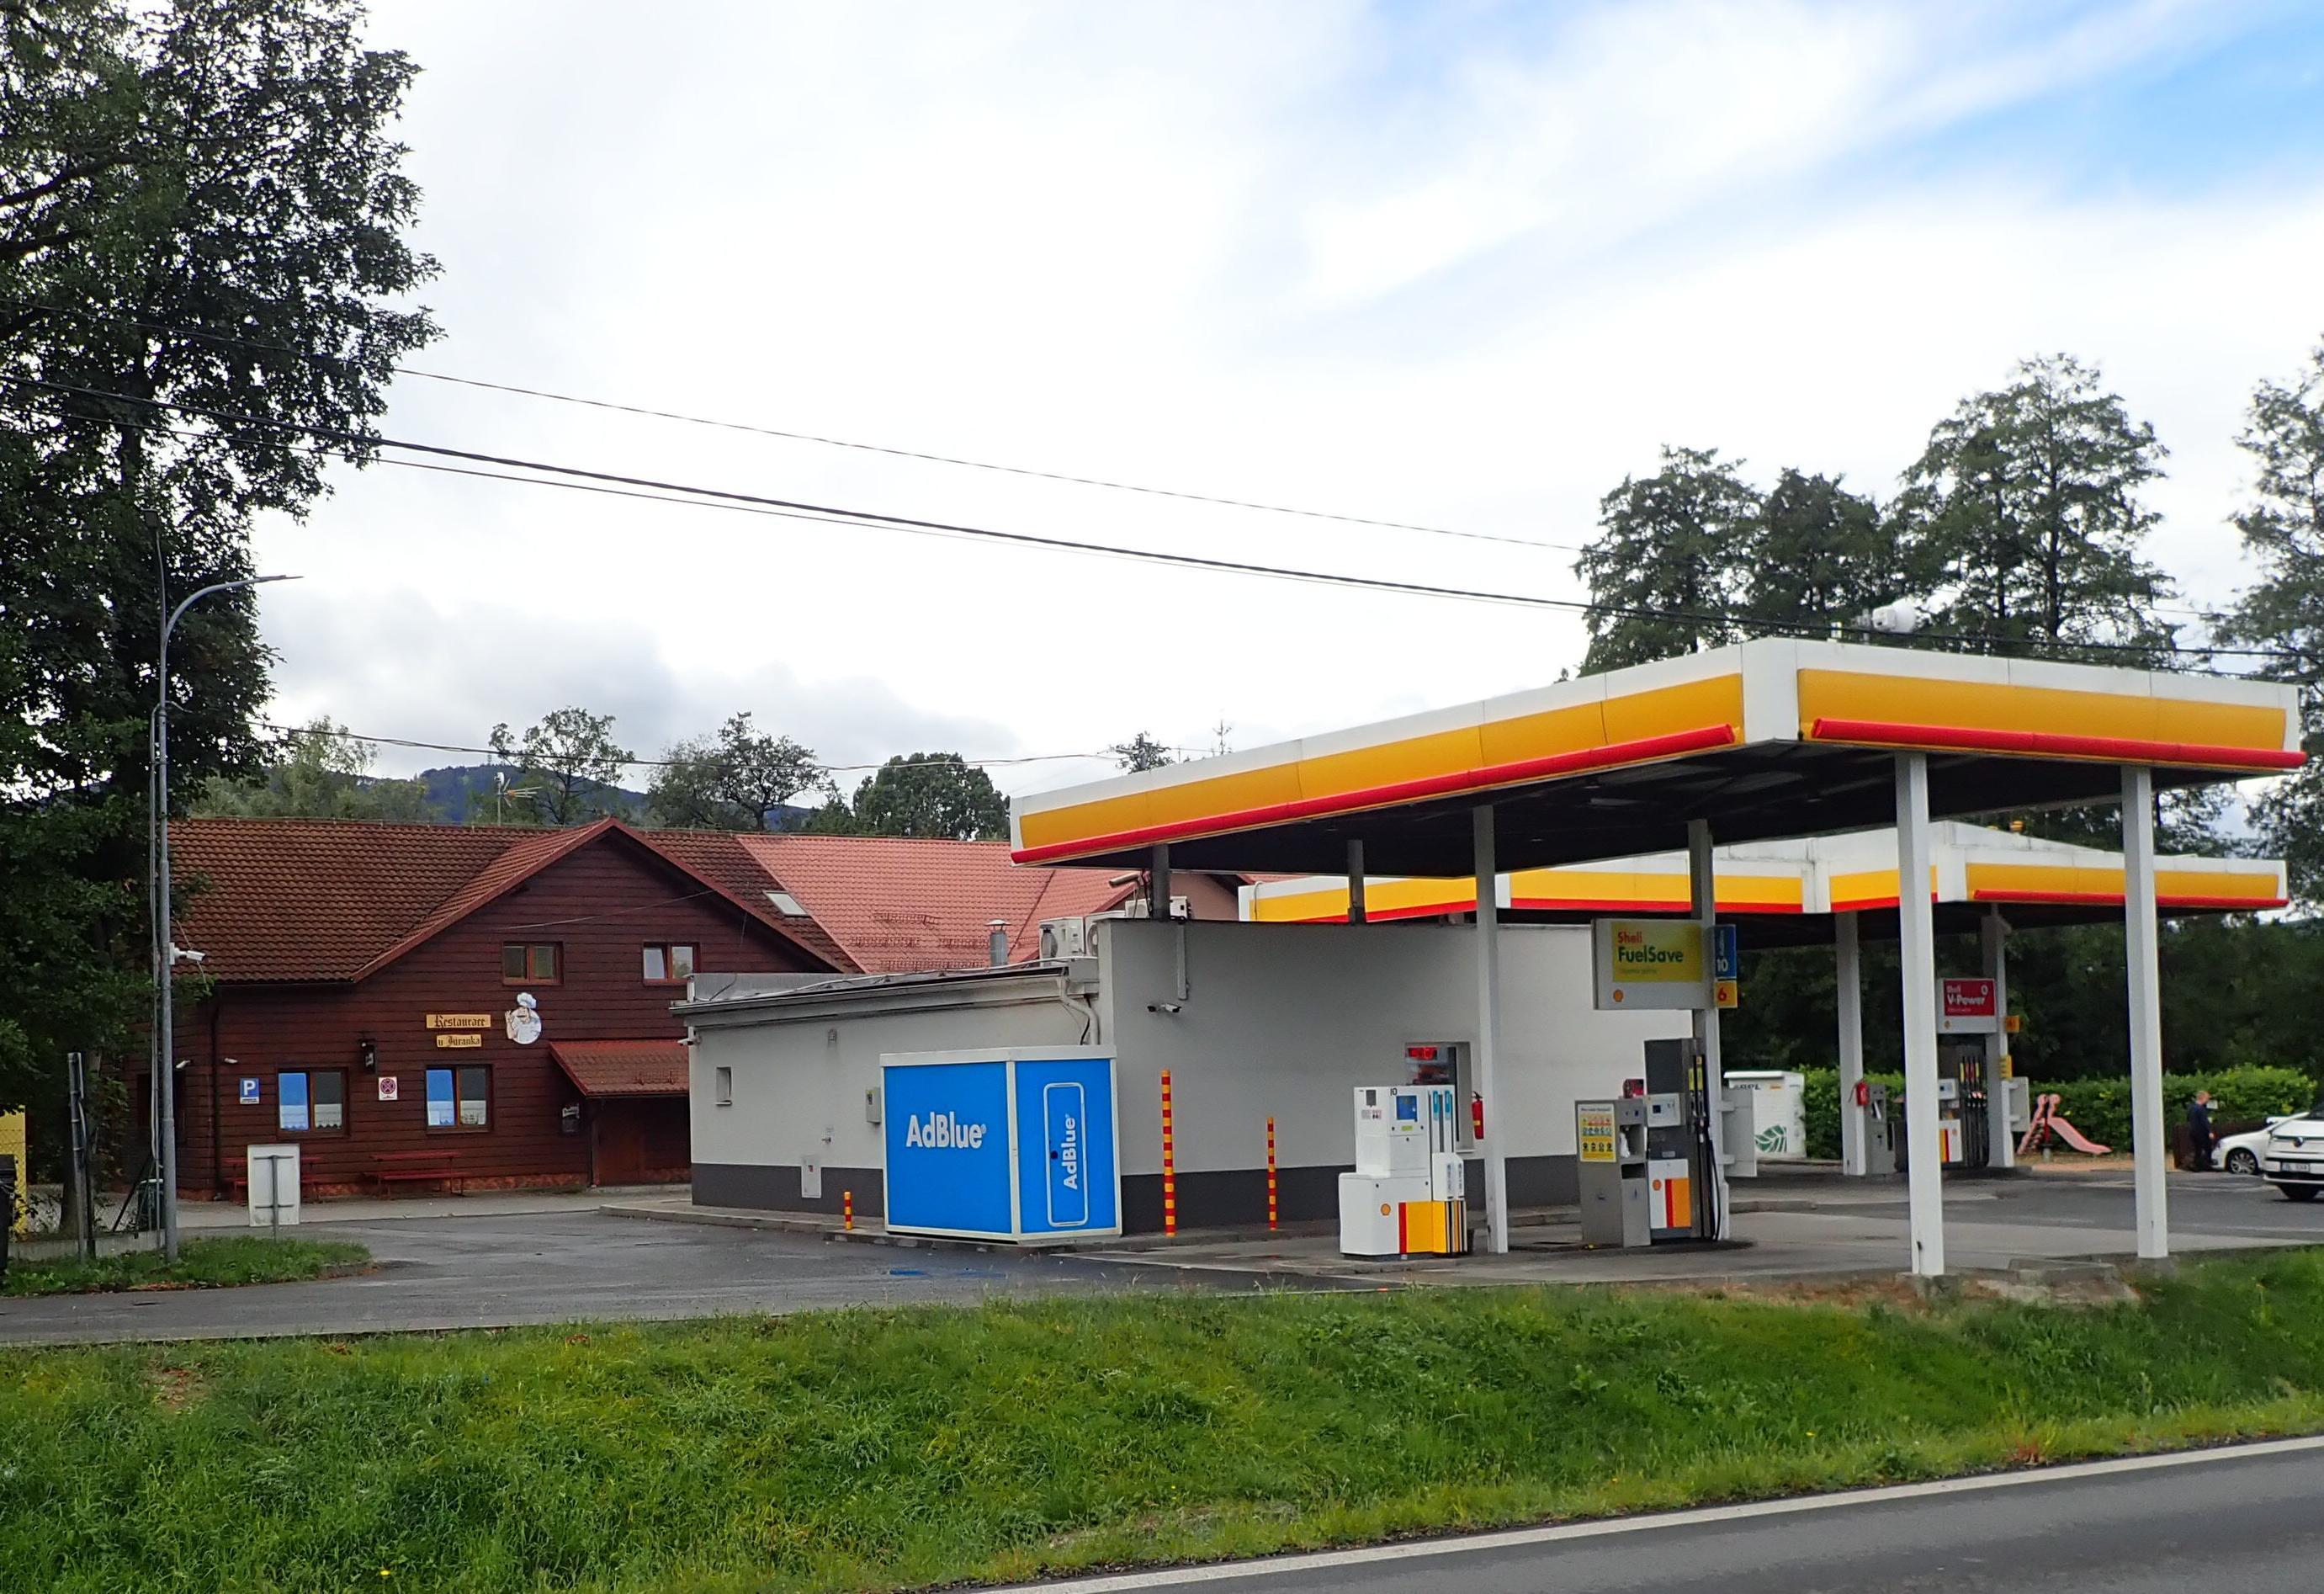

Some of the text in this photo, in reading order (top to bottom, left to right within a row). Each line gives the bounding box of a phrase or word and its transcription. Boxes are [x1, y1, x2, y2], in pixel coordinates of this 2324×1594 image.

[1617, 931, 1642, 943] Shell
[1618, 945, 1684, 963] FuelSave
[1716, 959, 1729, 972] 10
[1717, 987, 1727, 1002] 6
[1947, 994, 1985, 1005] V-Power
[434, 1014, 485, 1028] Restaurace
[244, 1080, 256, 1096] P
